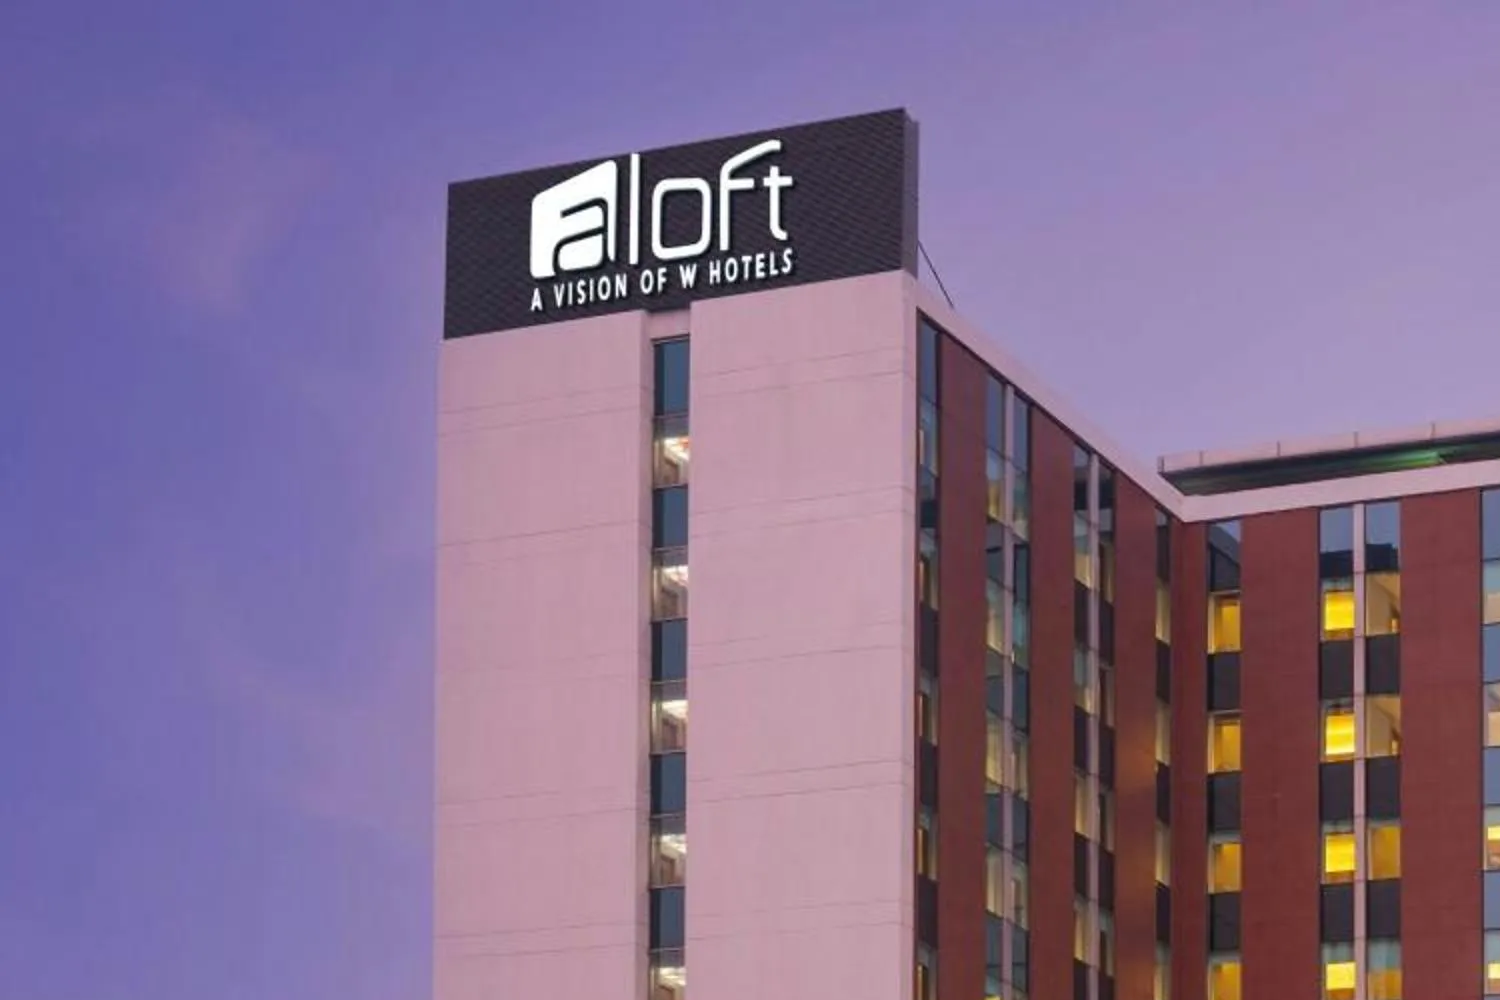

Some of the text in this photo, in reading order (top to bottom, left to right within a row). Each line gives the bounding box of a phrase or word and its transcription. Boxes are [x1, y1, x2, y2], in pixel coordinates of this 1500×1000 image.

[529, 139, 793, 278] aloft
[530, 247, 794, 311] A VISION OF W HOTELS
